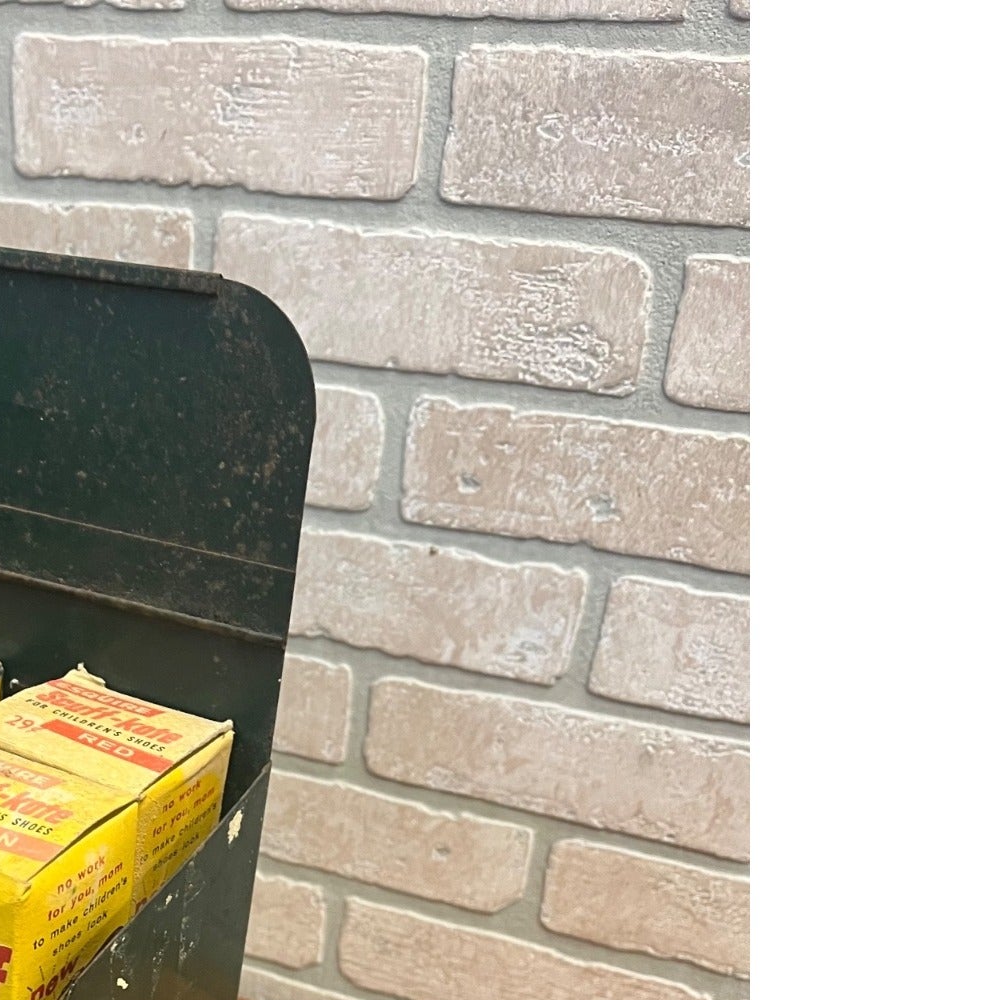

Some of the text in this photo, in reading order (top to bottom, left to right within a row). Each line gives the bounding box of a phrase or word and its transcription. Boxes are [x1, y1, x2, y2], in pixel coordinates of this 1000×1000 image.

[25, 698, 166, 752] FOR CHILDREN'S SHOES
[36, 690, 183, 744] Scuff-kote
[77, 733, 135, 757] RED
[152, 821, 167, 838] for
[193, 787, 216, 809] mom
[161, 781, 202, 813] no work
[11, 818, 53, 837] SHOES
[152, 837, 176, 856] make
[47, 903, 67, 922] for
[98, 861, 124, 887] mom
[57, 856, 106, 894] no work
[32, 936, 45, 951] to
[50, 914, 79, 940] make
[82, 877, 128, 917] children's
[52, 910, 108, 957] shoes look
